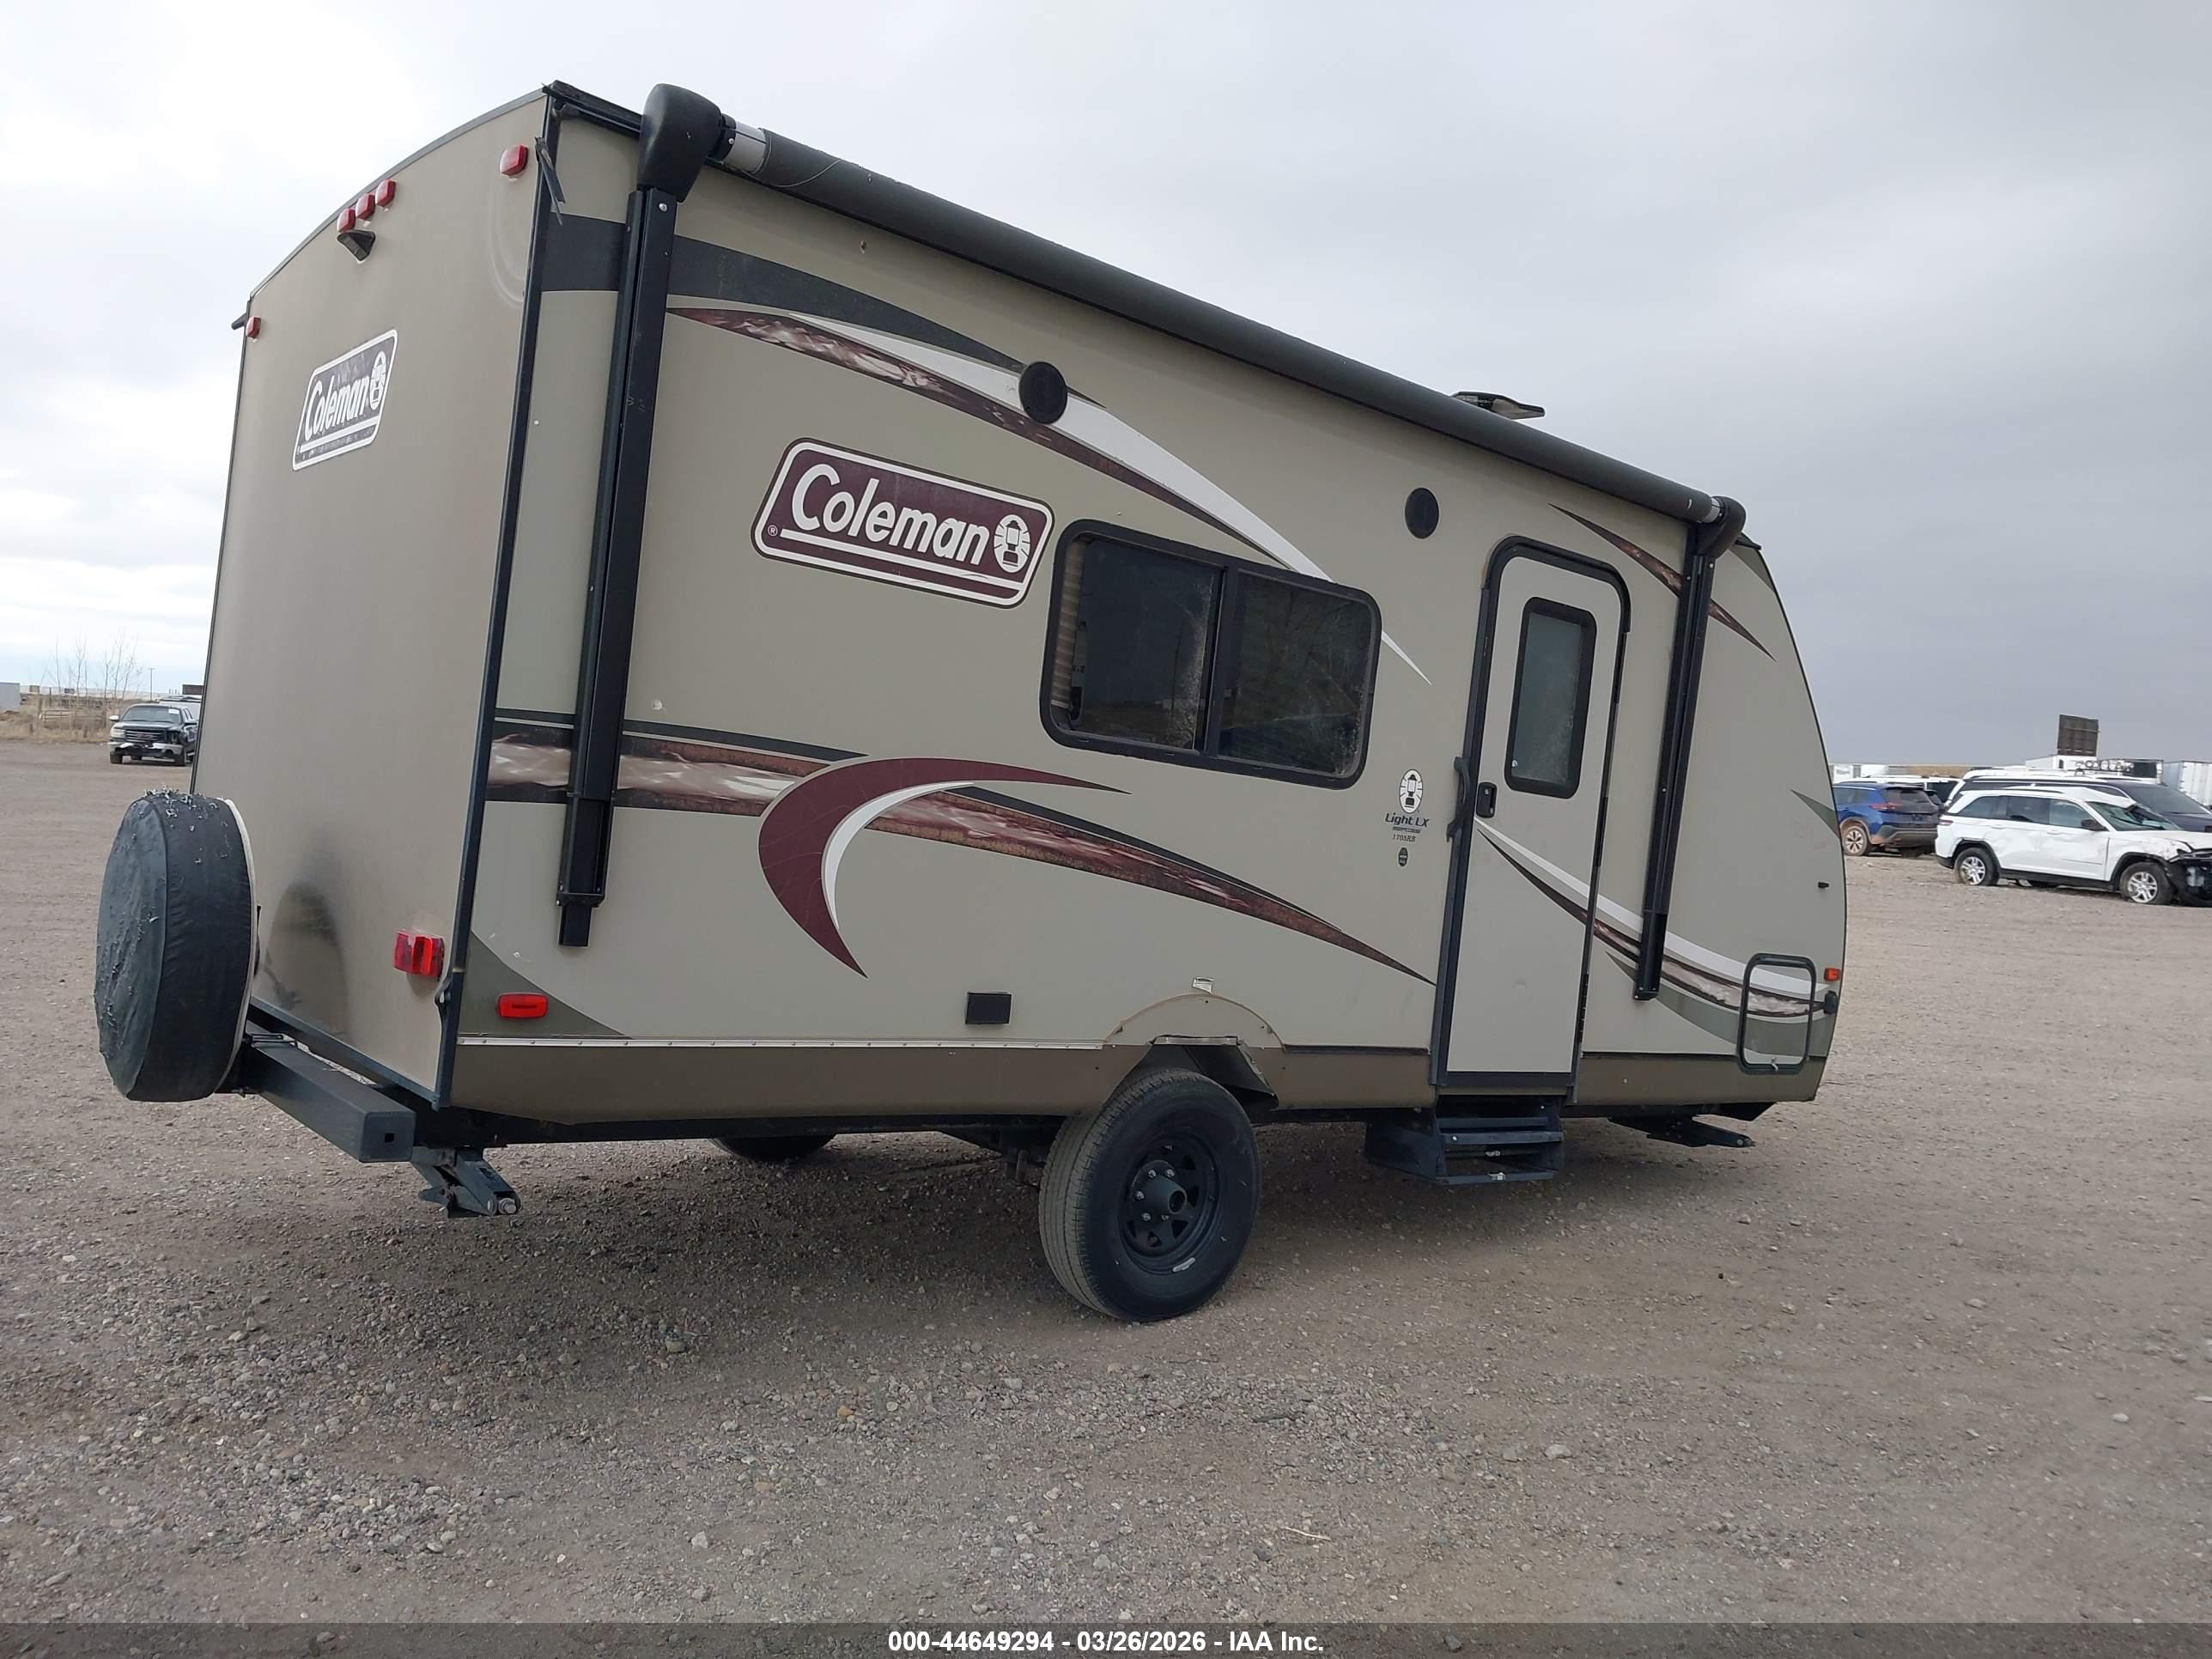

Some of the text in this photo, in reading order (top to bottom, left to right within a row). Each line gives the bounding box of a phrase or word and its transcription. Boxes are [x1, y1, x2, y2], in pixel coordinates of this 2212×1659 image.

[305, 375, 369, 441] Coleman
[792, 464, 990, 566] Coleman
[1385, 812, 1430, 827] Light LX
